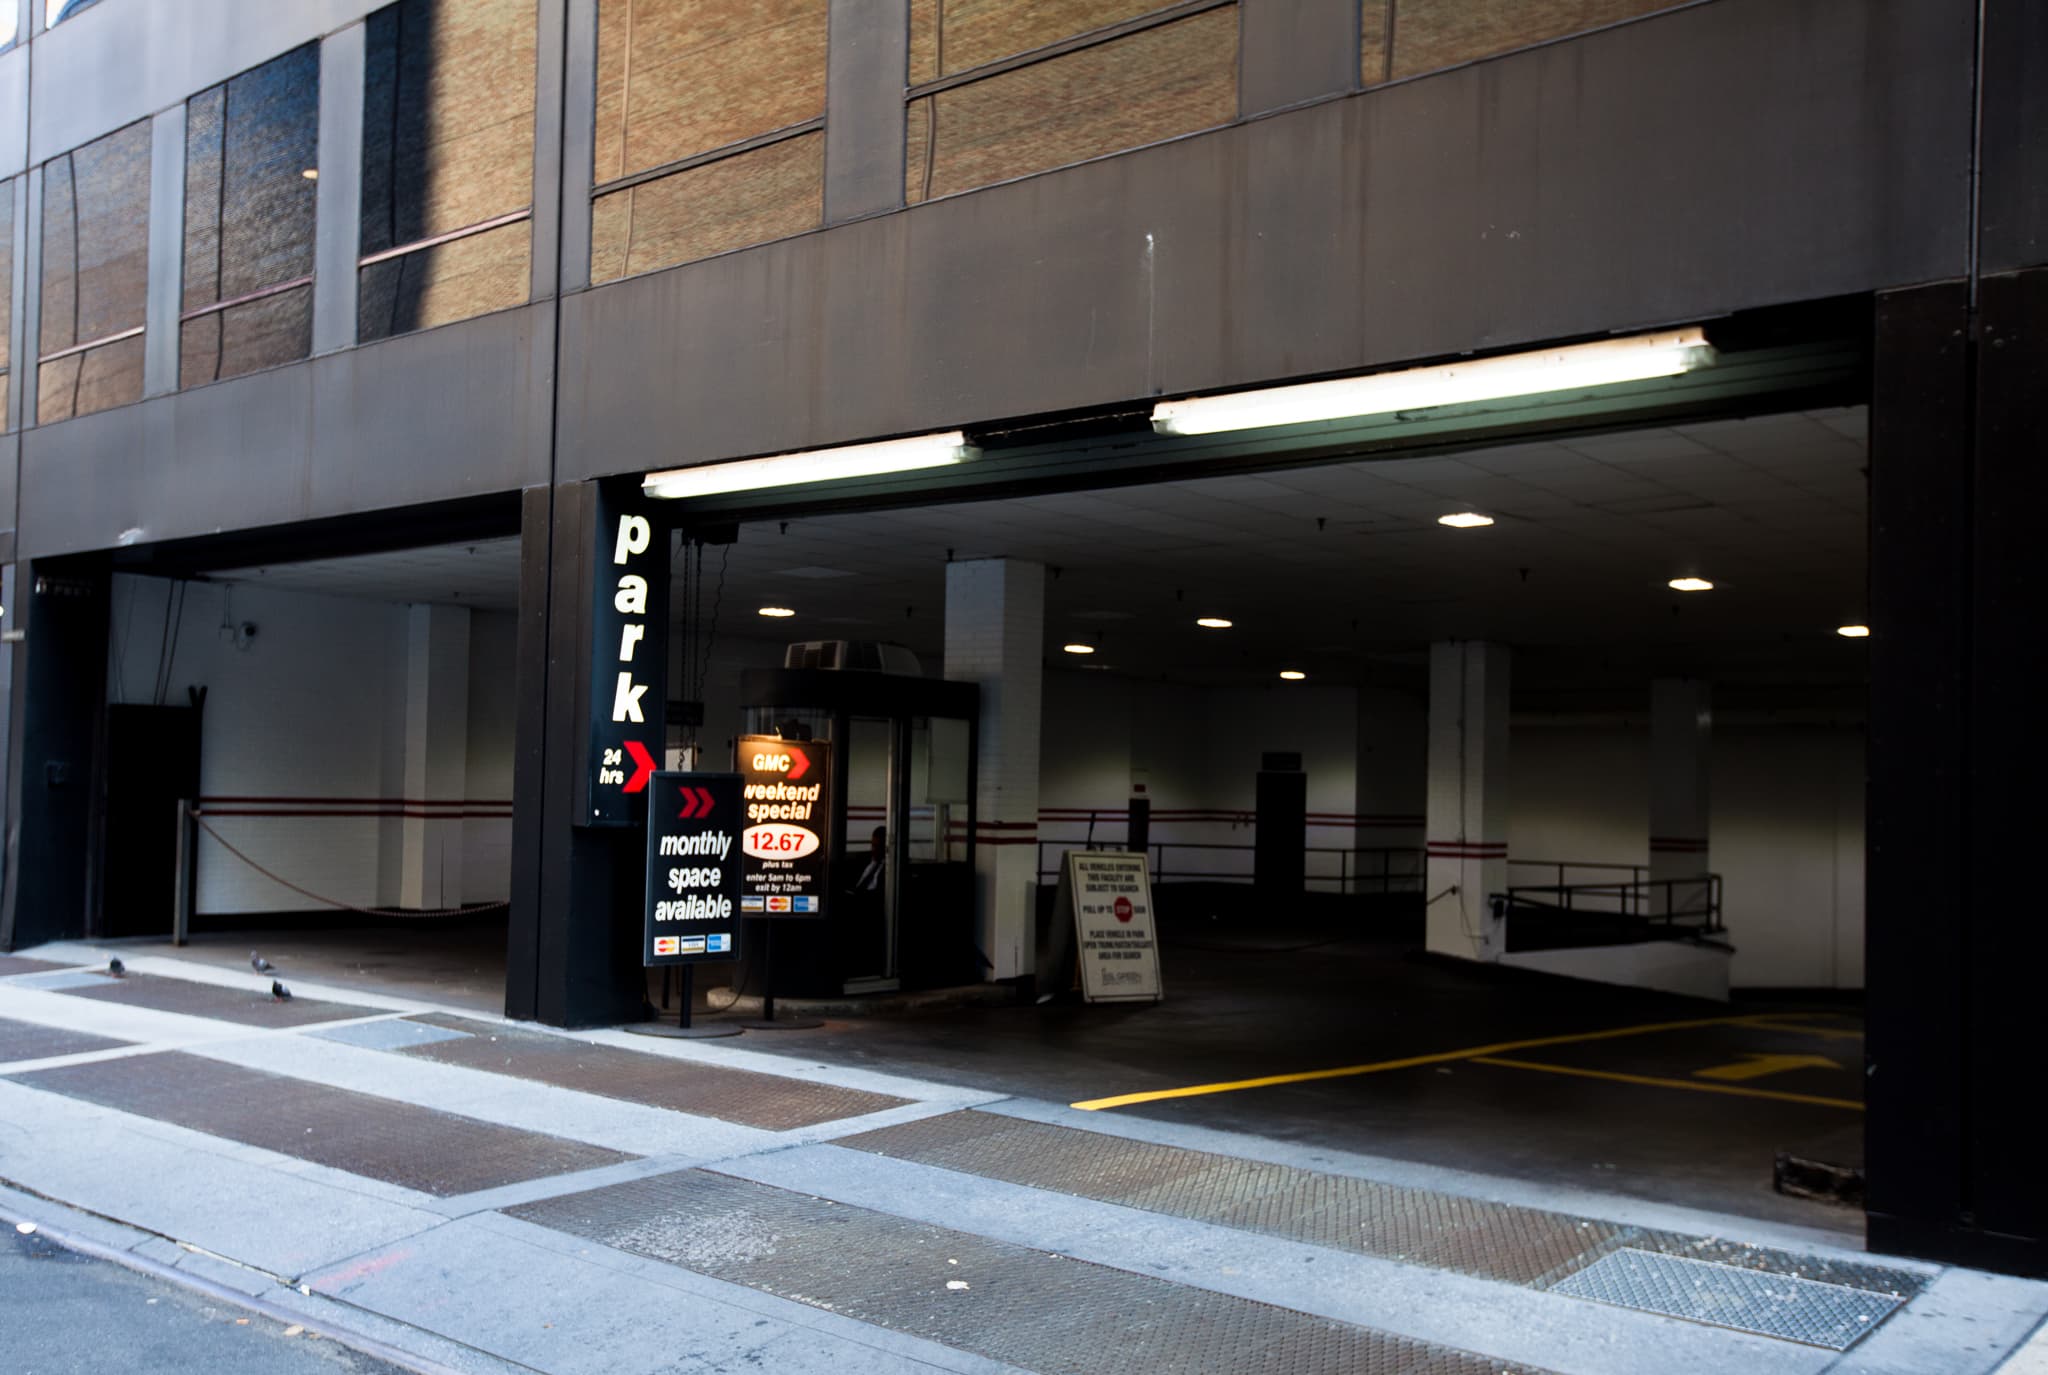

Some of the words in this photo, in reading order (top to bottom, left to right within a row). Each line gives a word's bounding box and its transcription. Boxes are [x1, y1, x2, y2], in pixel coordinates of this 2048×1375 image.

[614, 514, 651, 723] park
[603, 748, 622, 766] 24
[752, 753, 790, 773] GMC
[599, 767, 624, 785] hrs
[747, 801, 812, 824] special
[659, 830, 732, 861] monthly
[751, 832, 805, 851] 12.67
[762, 861, 780, 870] plus
[781, 861, 793, 869] tax
[1079, 863, 1089, 871] ALL
[1090, 863, 1114, 871] VEHICLES
[668, 867, 722, 894] space
[745, 873, 766, 882] enter
[768, 873, 784, 882] 5am
[786, 873, 793, 882] to
[1088, 873, 1099, 881] THIS
[1101, 873, 1123, 882] FACILITY
[1125, 874, 1135, 882] ARE
[755, 883, 770, 892] exit
[771, 883, 780, 893] by
[782, 884, 802, 892] 12am
[1086, 884, 1109, 892] SUBJECT
[1110, 884, 1117, 892] TO
[1119, 884, 1139, 892] SEARCH
[655, 894, 732, 921] available
[1083, 905, 1096, 913] PULL
[1097, 905, 1104, 913] UP
[1116, 905, 1129, 913] STOP
[1089, 930, 1104, 938] PLACE
[1132, 930, 1144, 938] PARK
[1098, 951, 1111, 960] AREA
[1112, 951, 1121, 960] FOR
